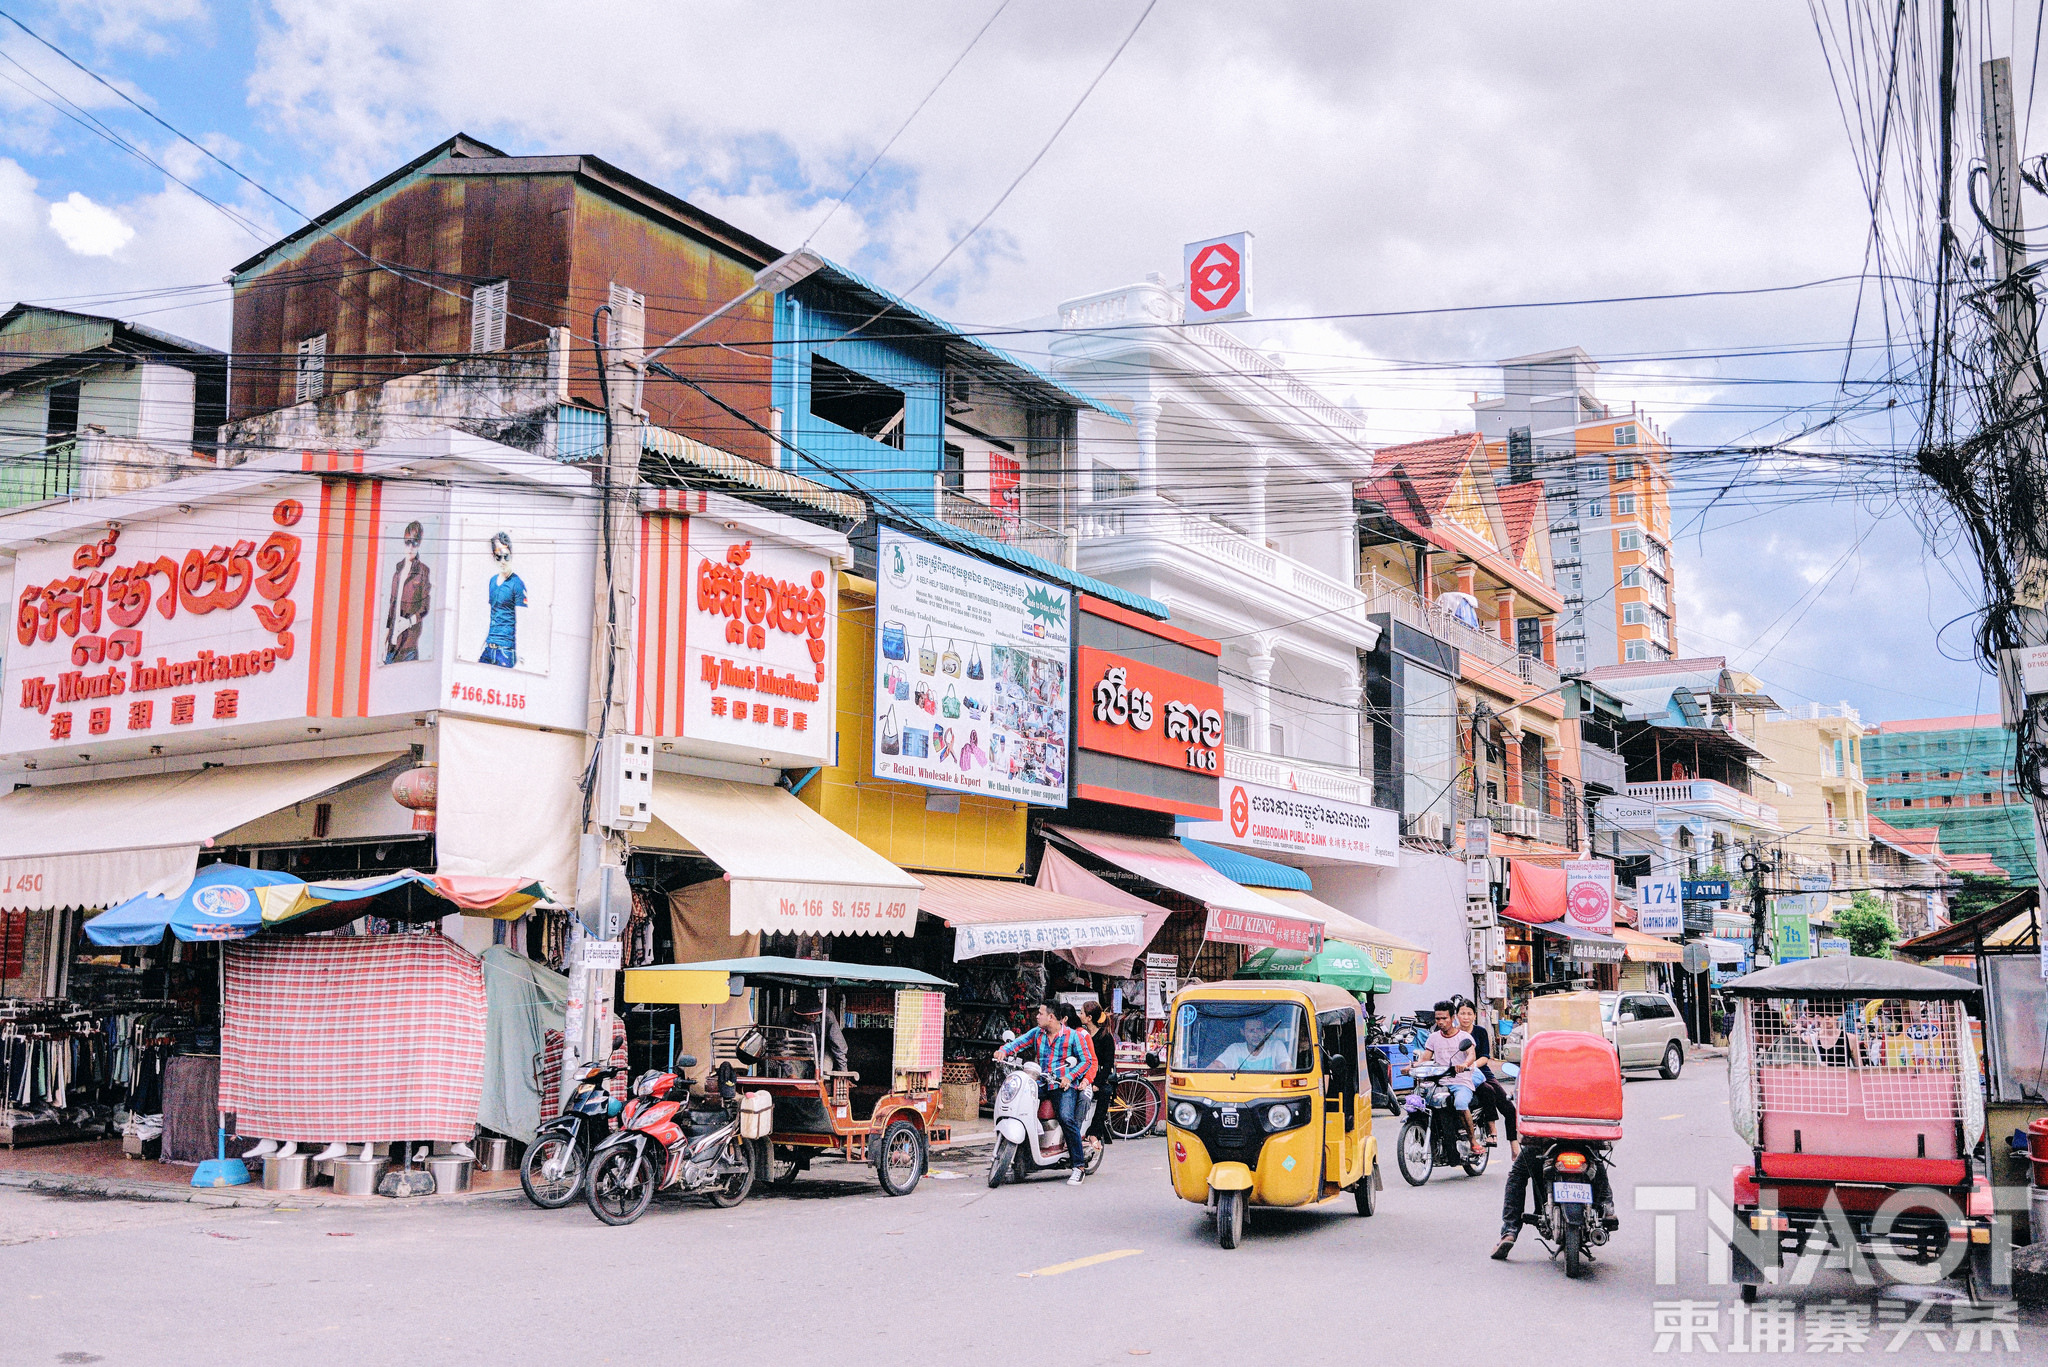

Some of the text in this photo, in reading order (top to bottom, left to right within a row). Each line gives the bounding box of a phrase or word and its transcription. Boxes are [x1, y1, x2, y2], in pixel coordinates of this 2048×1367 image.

[939, 581, 950, 592] TEAM
[950, 584, 955, 593] OF
[968, 590, 978, 600] WITH
[890, 604, 904, 616] Offers
[917, 610, 931, 622] Traded
[1046, 630, 1068, 643] Available
[20, 649, 276, 715] My Mom's Inheritance
[701, 654, 720, 690] My
[756, 666, 820, 702] Inheritance
[1186, 746, 1217, 770] 168
[893, 762, 982, 788] Retail, Wholesale & Export
[988, 780, 996, 790] We
[996, 780, 1012, 793] thank
[1012, 786, 1022, 796] you
[1022, 786, 1030, 796] for
[1030, 788, 1042, 799] your
[1042, 789, 1061, 802] support
[1620, 809, 1652, 817] CORNER
[1252, 824, 1327, 846] CAMBODIAN PUBLIC BANK
[16, 874, 43, 892] 450
[1696, 886, 1722, 895] ATM
[1641, 882, 1677, 905] 174
[780, 898, 798, 916] No.
[803, 899, 822, 916] 166
[832, 900, 846, 918] St.
[851, 901, 870, 918] 155
[886, 902, 906, 918] 450
[1781, 902, 1803, 912] Wing
[1225, 914, 1276, 935] LIM KIENG
[1643, 916, 1678, 928] CLOTHES SHOP
[1076, 924, 1136, 939] TA PROHM SILK
[1573, 944, 1584, 957] Kids
[1584, 946, 1588, 957] &
[1588, 946, 1596, 958] Me
[1596, 946, 1612, 961] Factory
[1270, 962, 1304, 971] Smart
[1332, 958, 1352, 968] 4G
